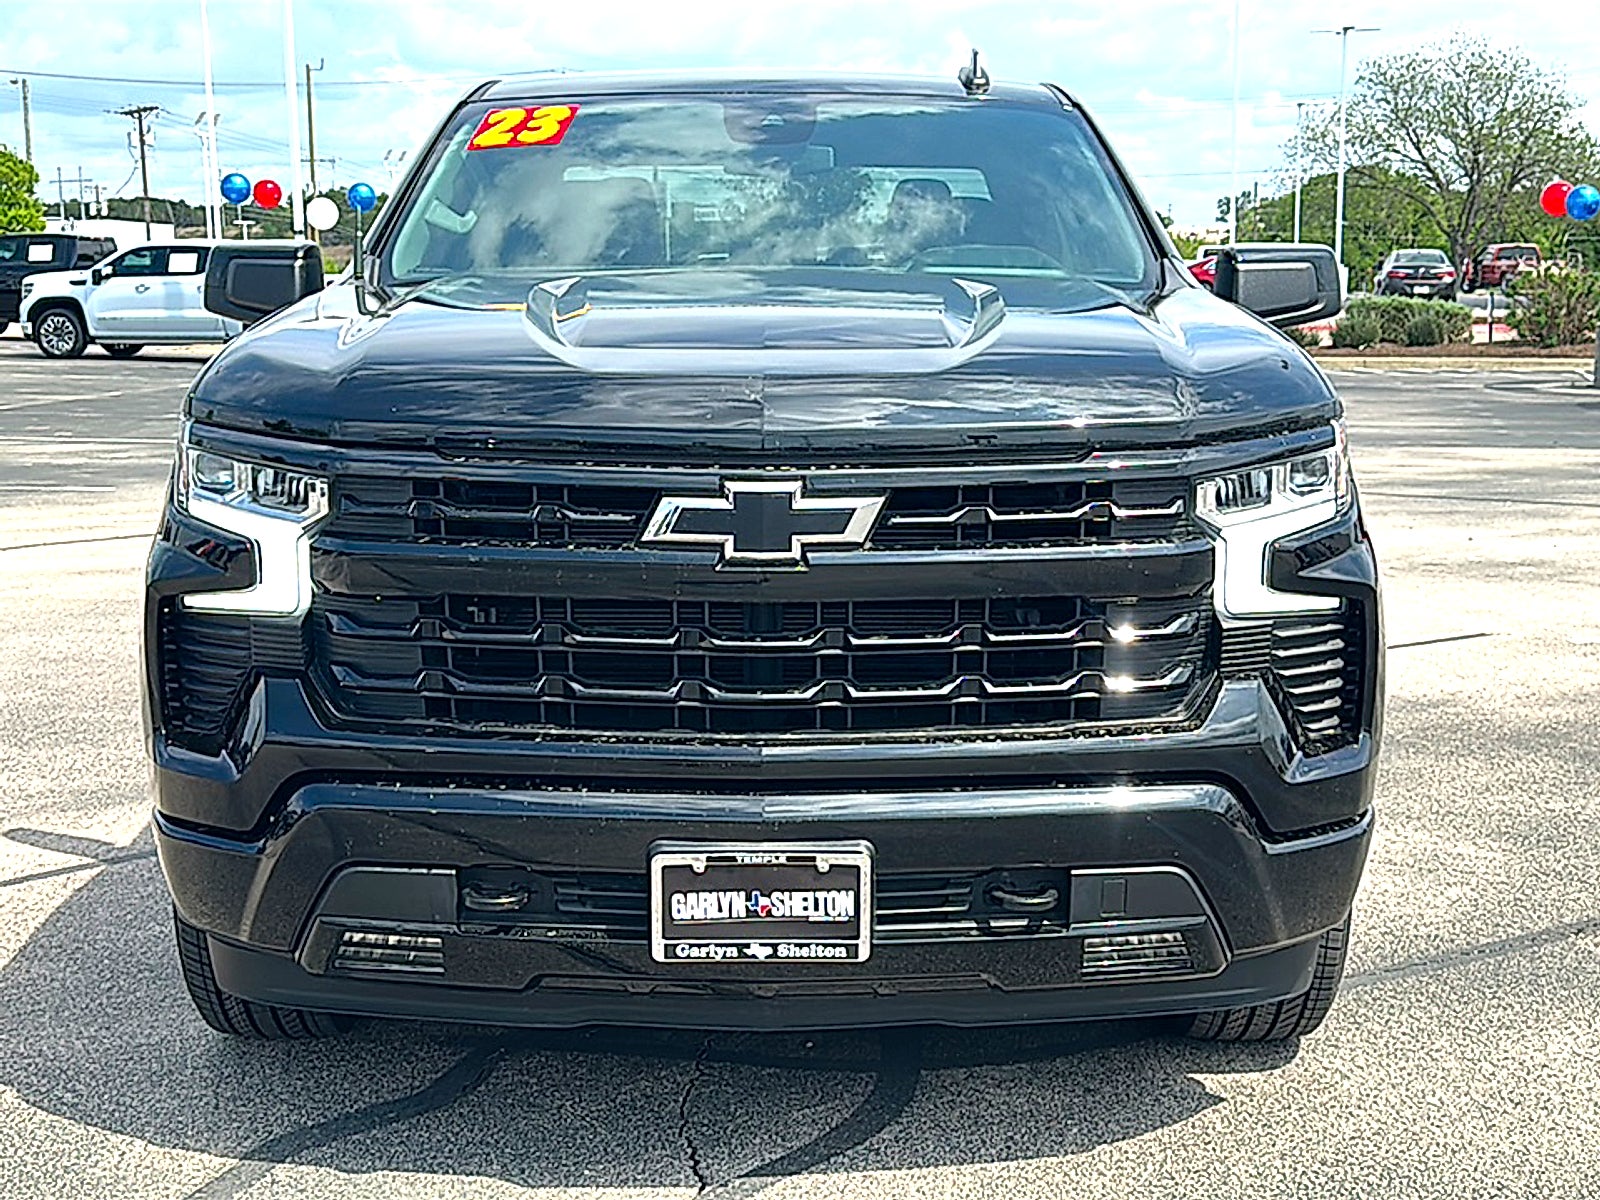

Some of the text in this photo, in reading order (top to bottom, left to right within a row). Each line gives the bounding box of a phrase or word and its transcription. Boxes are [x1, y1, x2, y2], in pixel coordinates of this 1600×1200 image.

[473, 106, 572, 147] 23
[671, 890, 855, 920] GARLYN SHELTON
[675, 944, 847, 960] Garlyn Shelton
